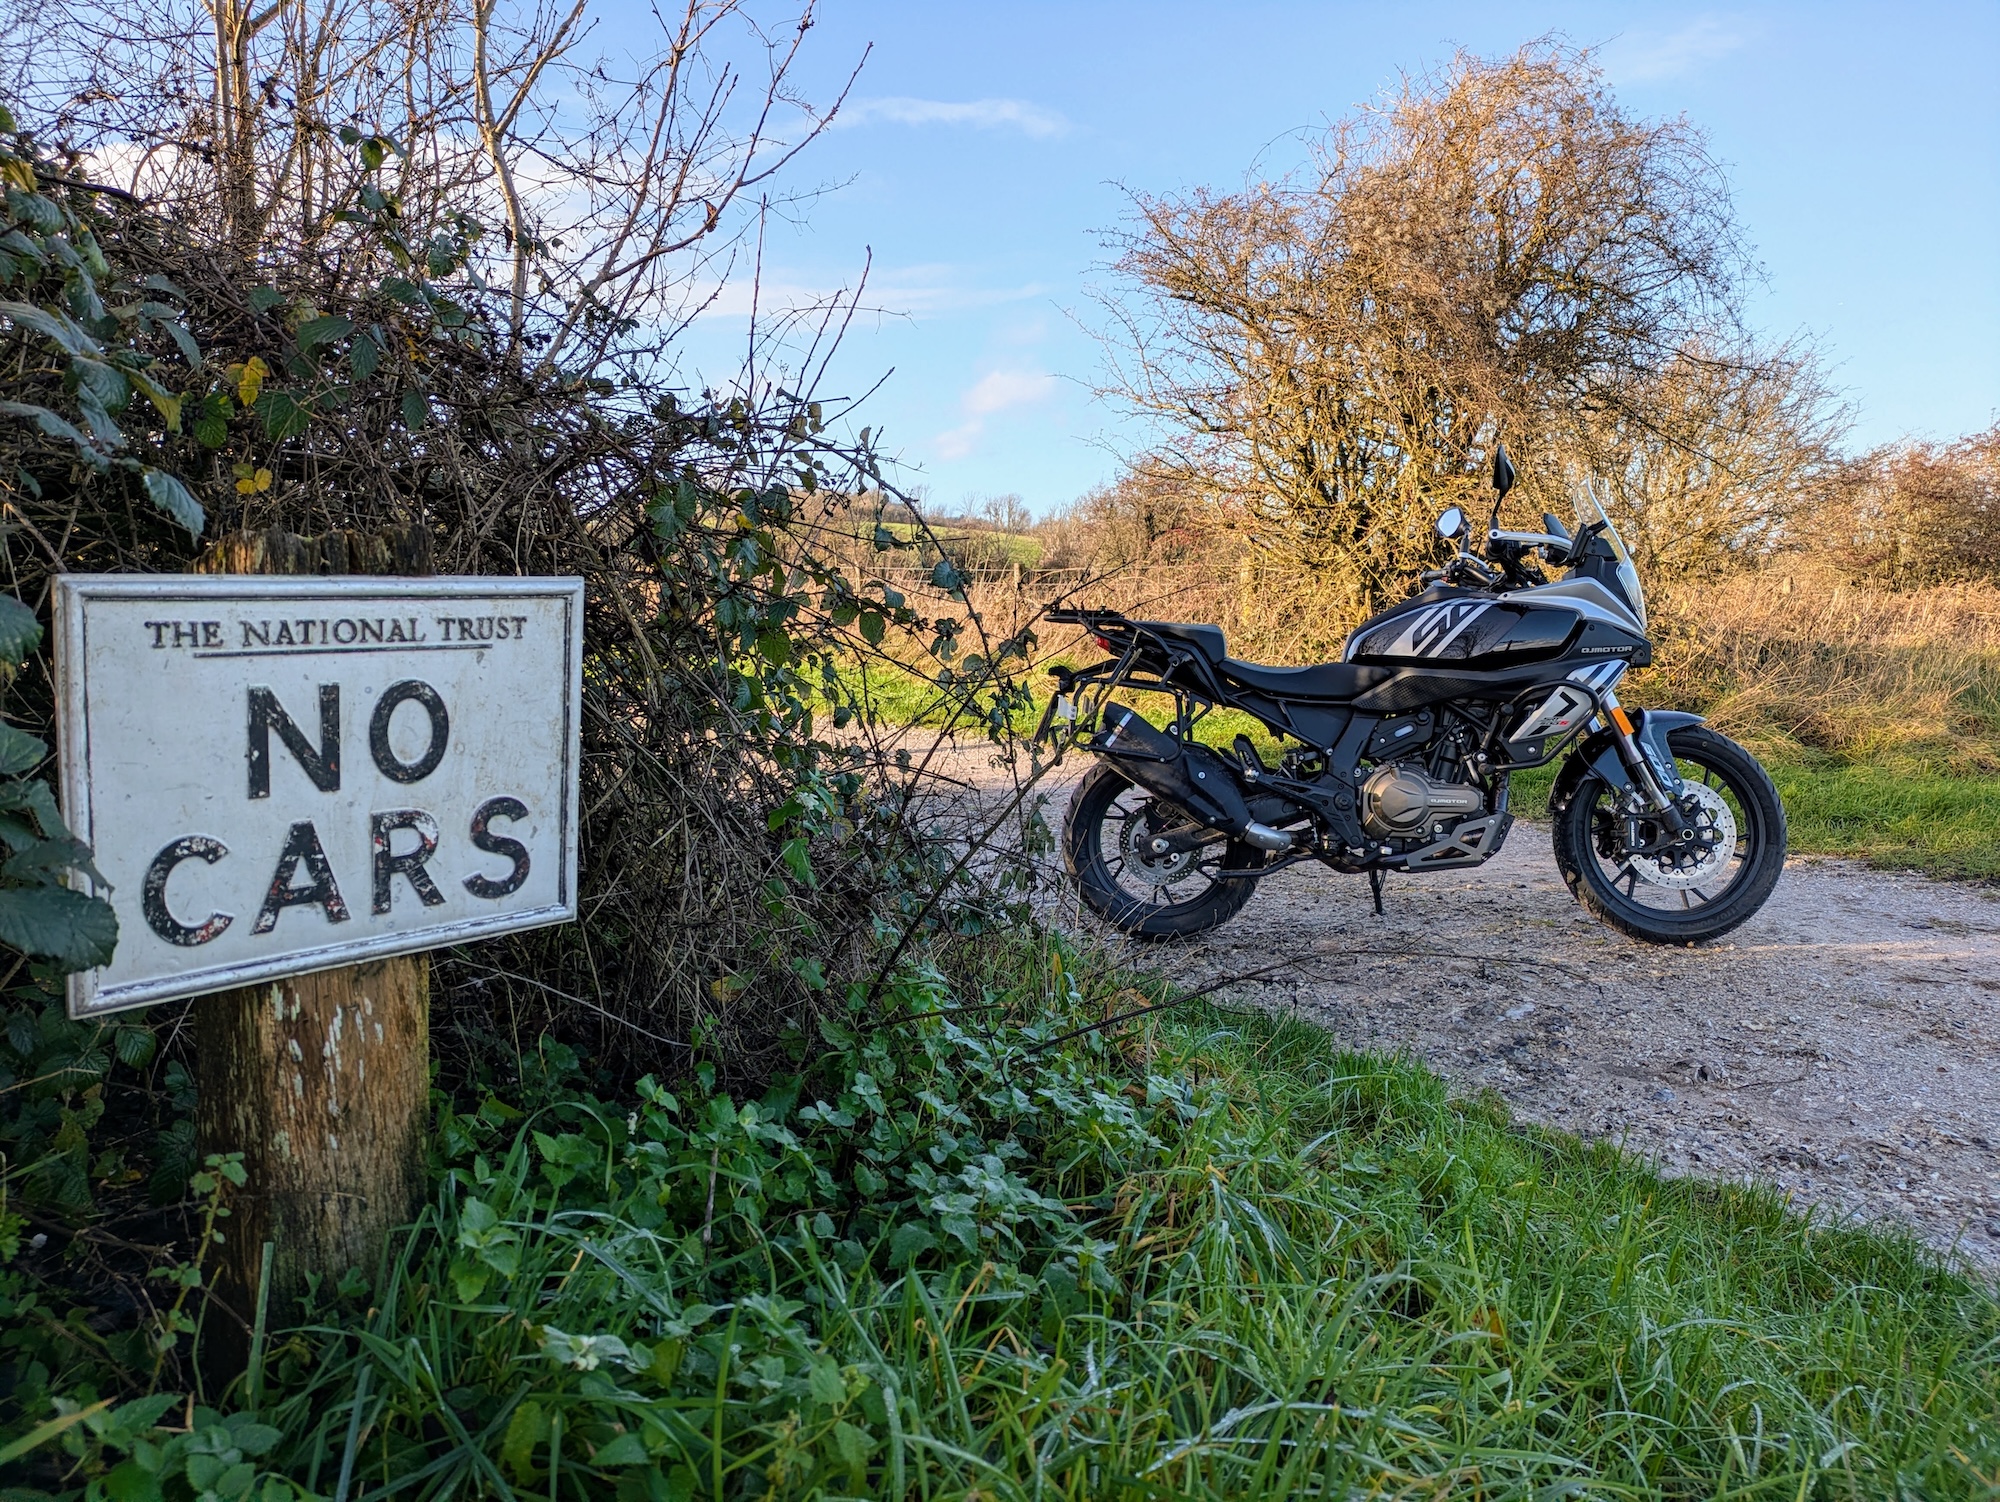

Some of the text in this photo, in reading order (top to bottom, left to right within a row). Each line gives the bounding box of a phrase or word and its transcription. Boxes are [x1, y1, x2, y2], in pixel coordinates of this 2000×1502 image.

[144, 615, 528, 649] THE NATIONAL TRUST
[1580, 645, 1633, 654] QJMOTOR
[246, 678, 450, 800] NO
[142, 796, 531, 947] CARS
